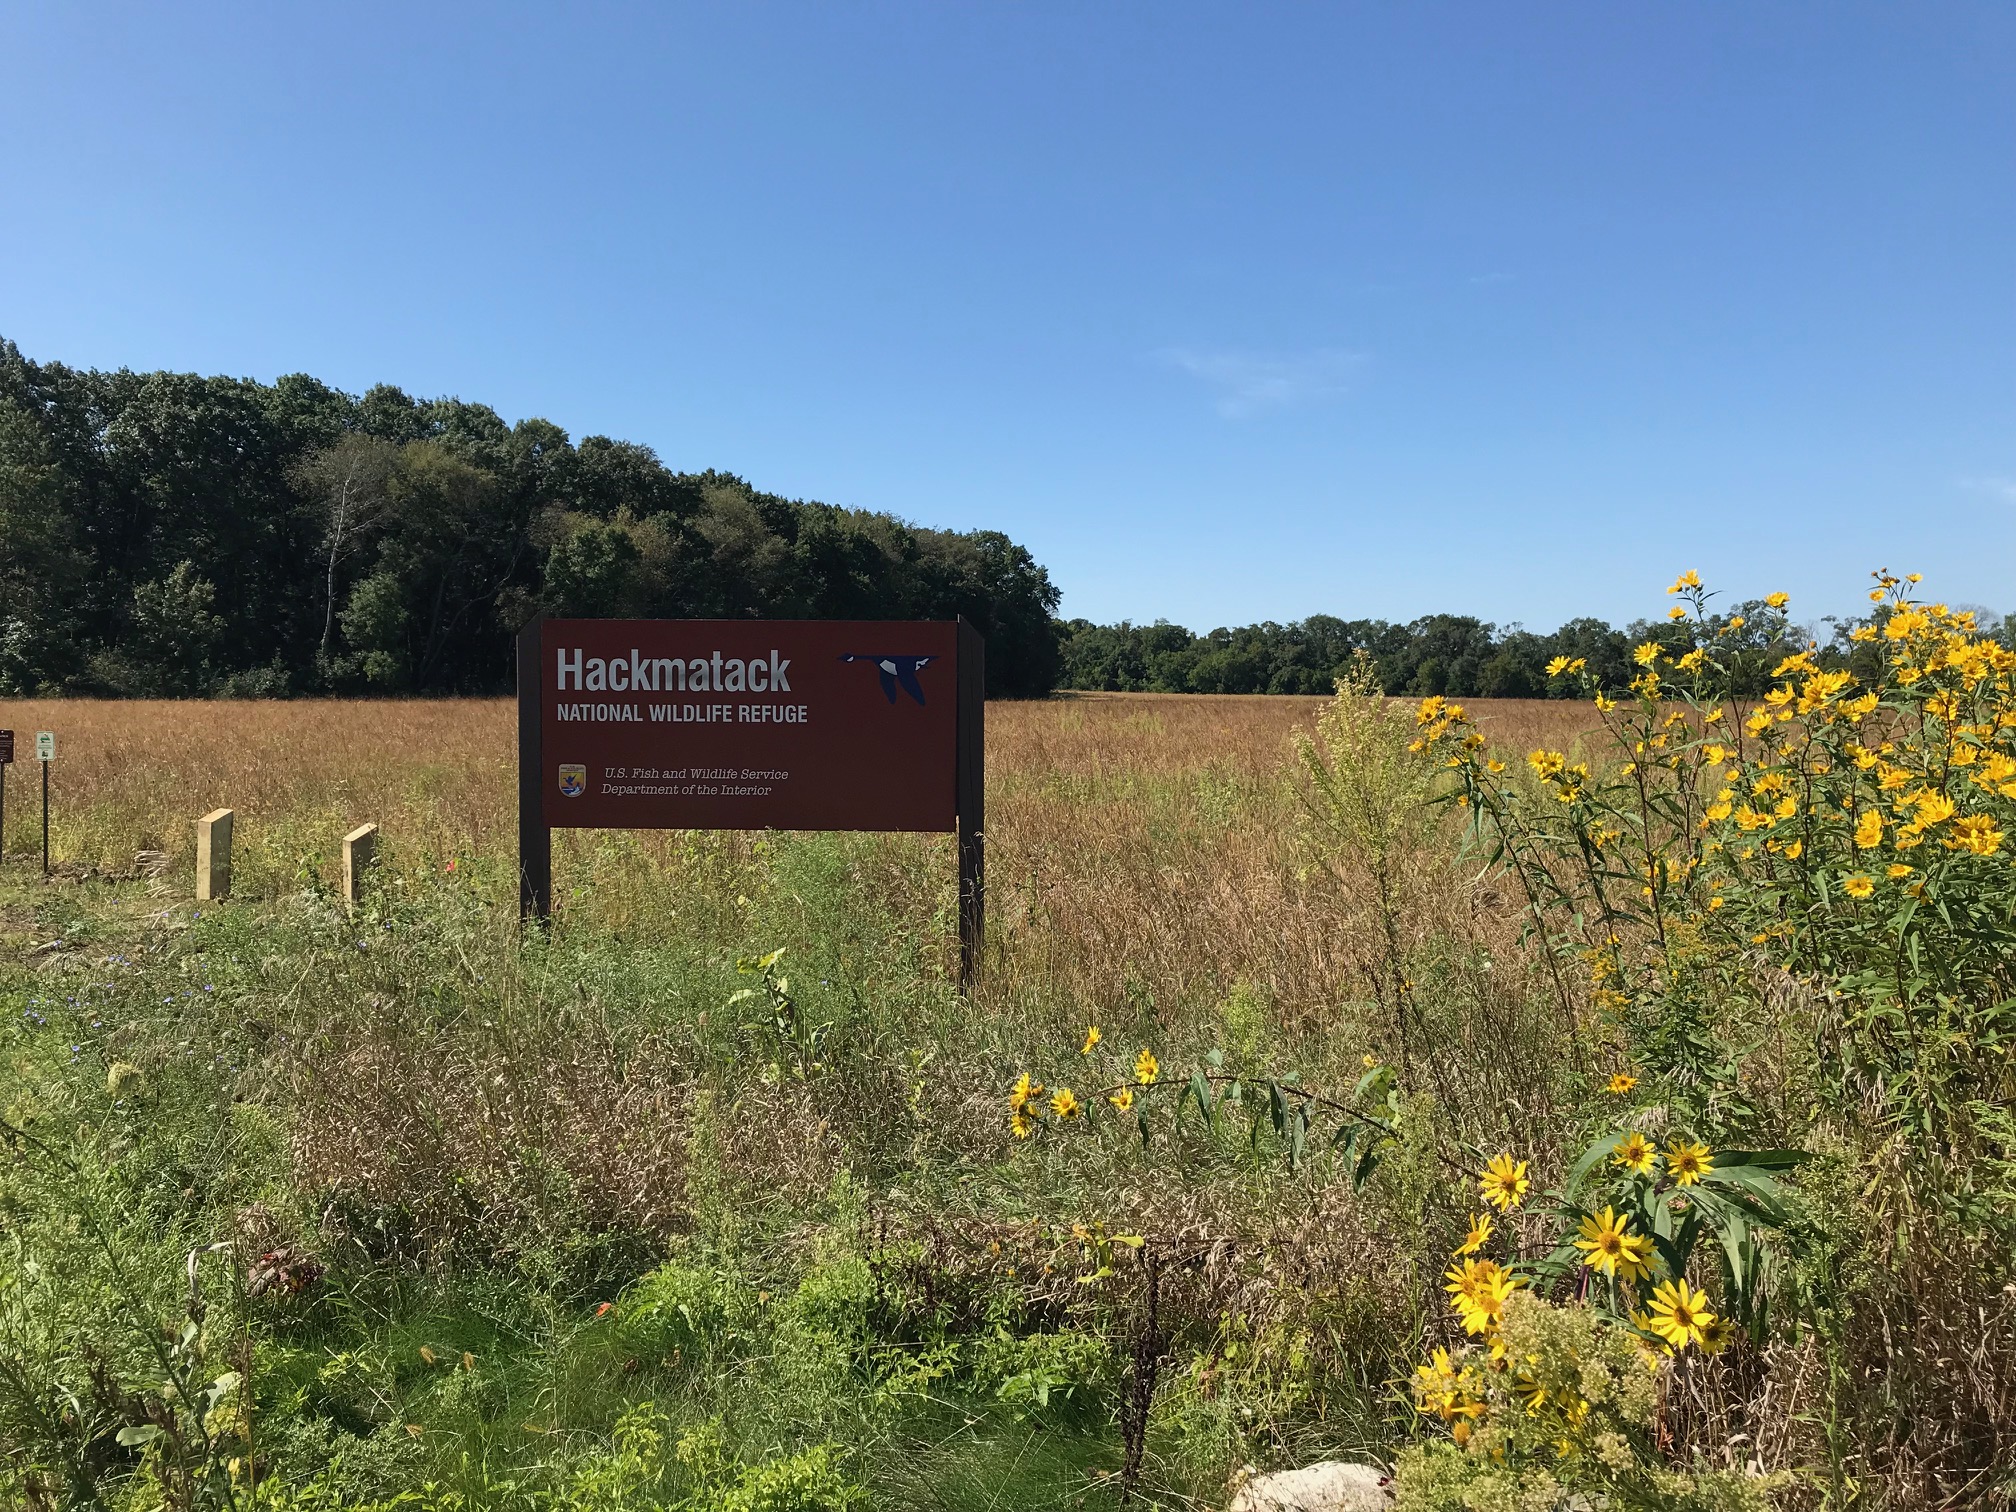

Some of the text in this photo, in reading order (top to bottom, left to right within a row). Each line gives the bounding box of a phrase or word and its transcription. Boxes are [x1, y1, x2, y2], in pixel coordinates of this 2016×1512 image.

[557, 648, 791, 692] Hackmatack
[557, 703, 808, 723] NATIONAL WILDLIFE REFUGE
[605, 767, 789, 781] U.S. Fish and Wildlife Service
[601, 783, 772, 797] Department of the Interior
